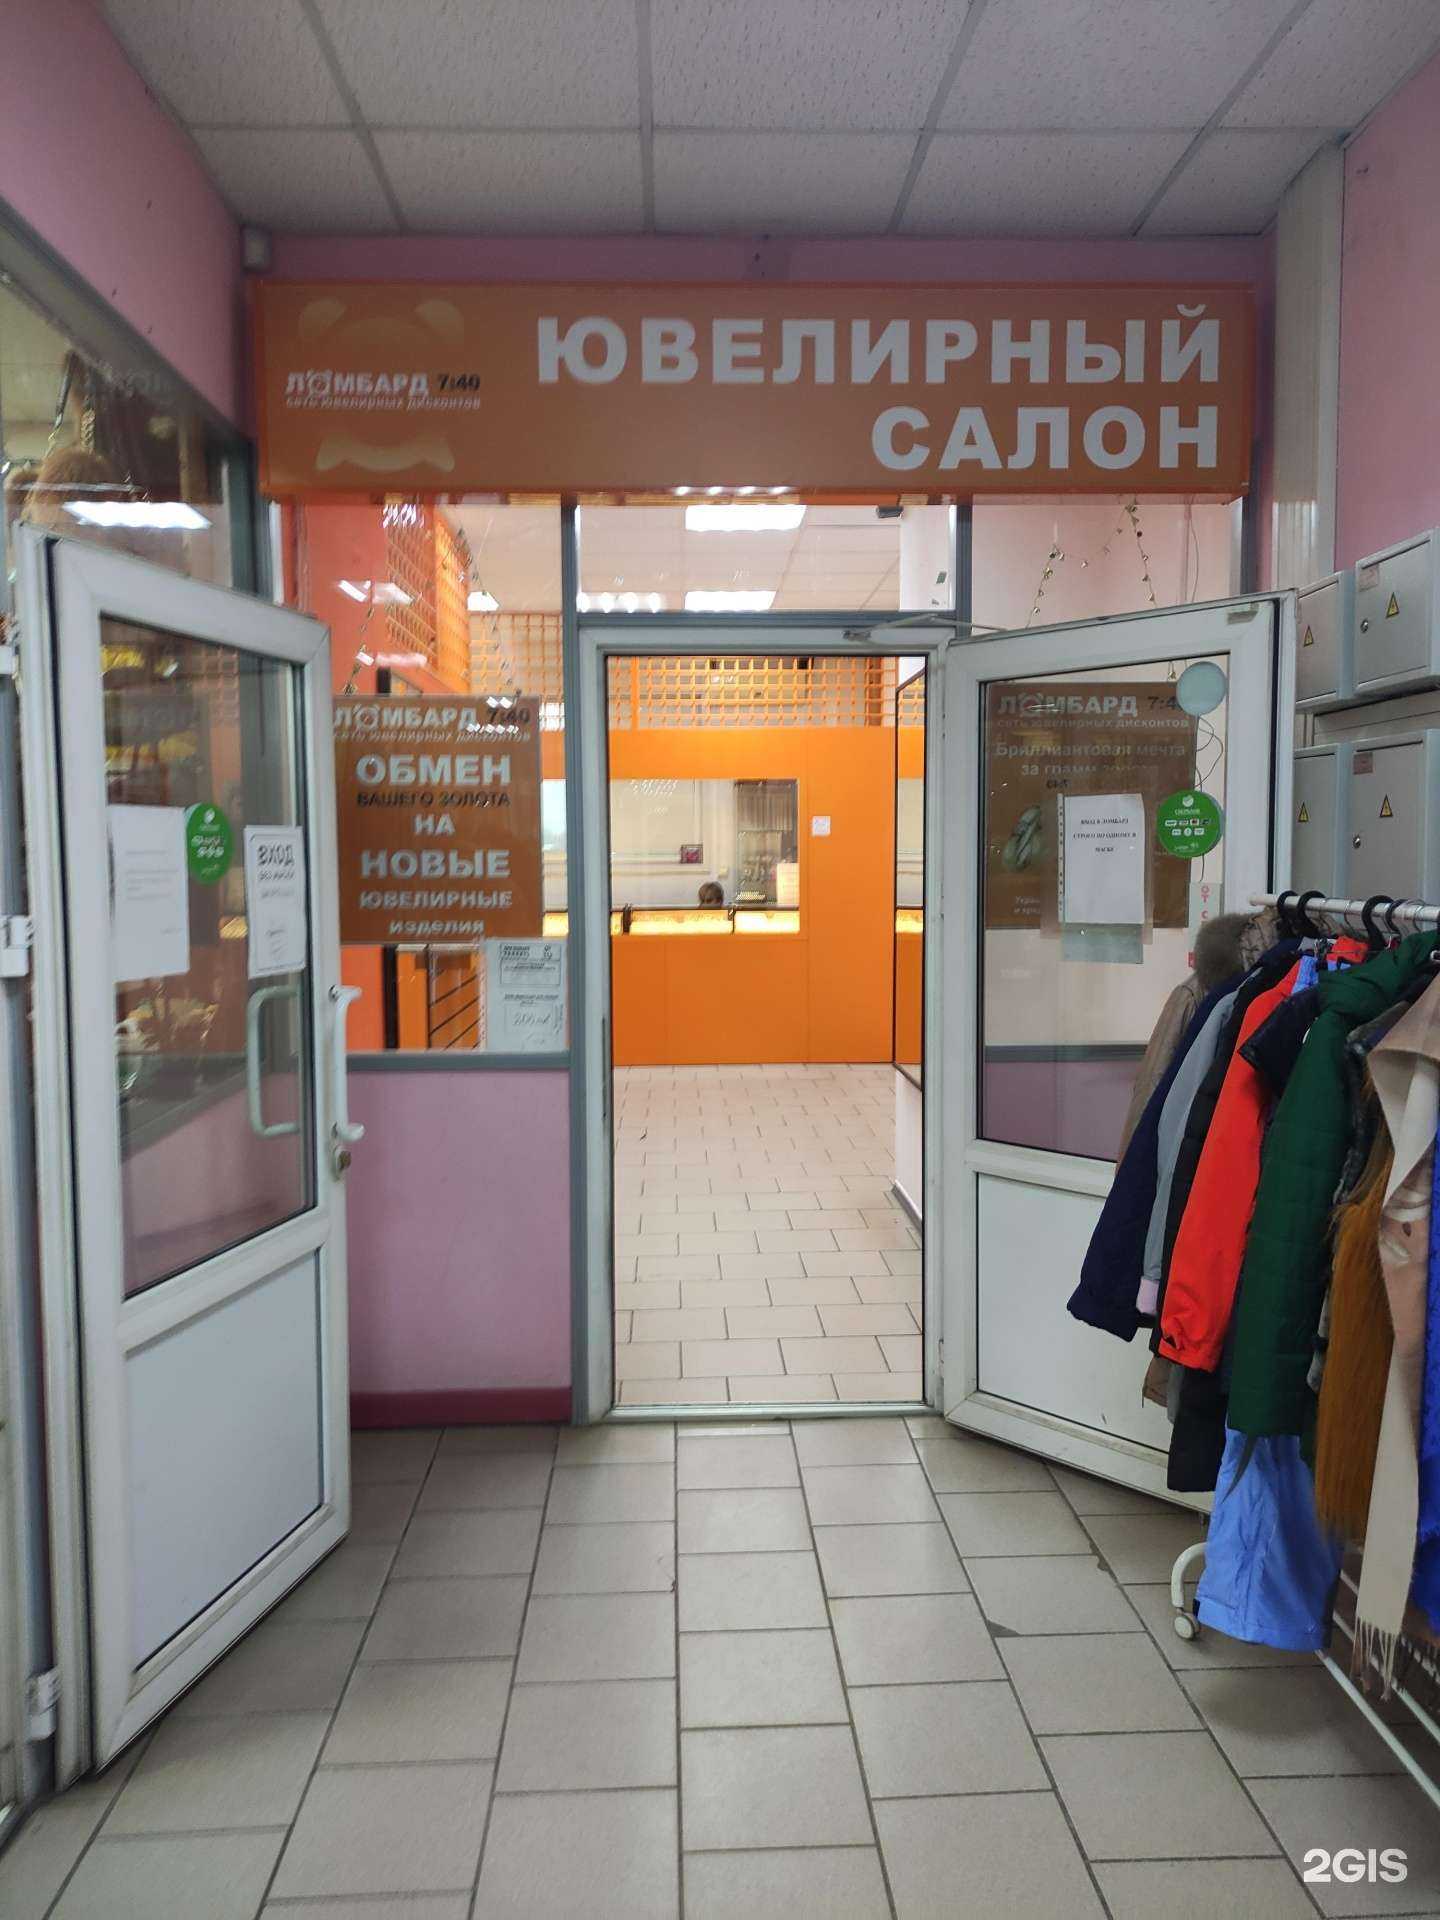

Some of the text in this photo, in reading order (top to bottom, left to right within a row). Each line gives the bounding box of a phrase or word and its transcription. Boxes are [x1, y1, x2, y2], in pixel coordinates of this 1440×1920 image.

[537, 304, 1221, 385] ЮВЕЛИРНЫЙ
[285, 369, 480, 397] ЛОМБАРД 7:40
[872, 406, 1219, 470] САЛОН
[334, 704, 478, 731] ЛОМБАРД
[998, 694, 1138, 717] ЛОМБАРД
[355, 754, 512, 785] ОБМЕН
[357, 792, 434, 807] ВАШЕГО
[414, 814, 456, 835] НА
[361, 850, 511, 879] НОВЫЕ
[359, 890, 513, 909] ЮВЕЛИРНЫЕ
